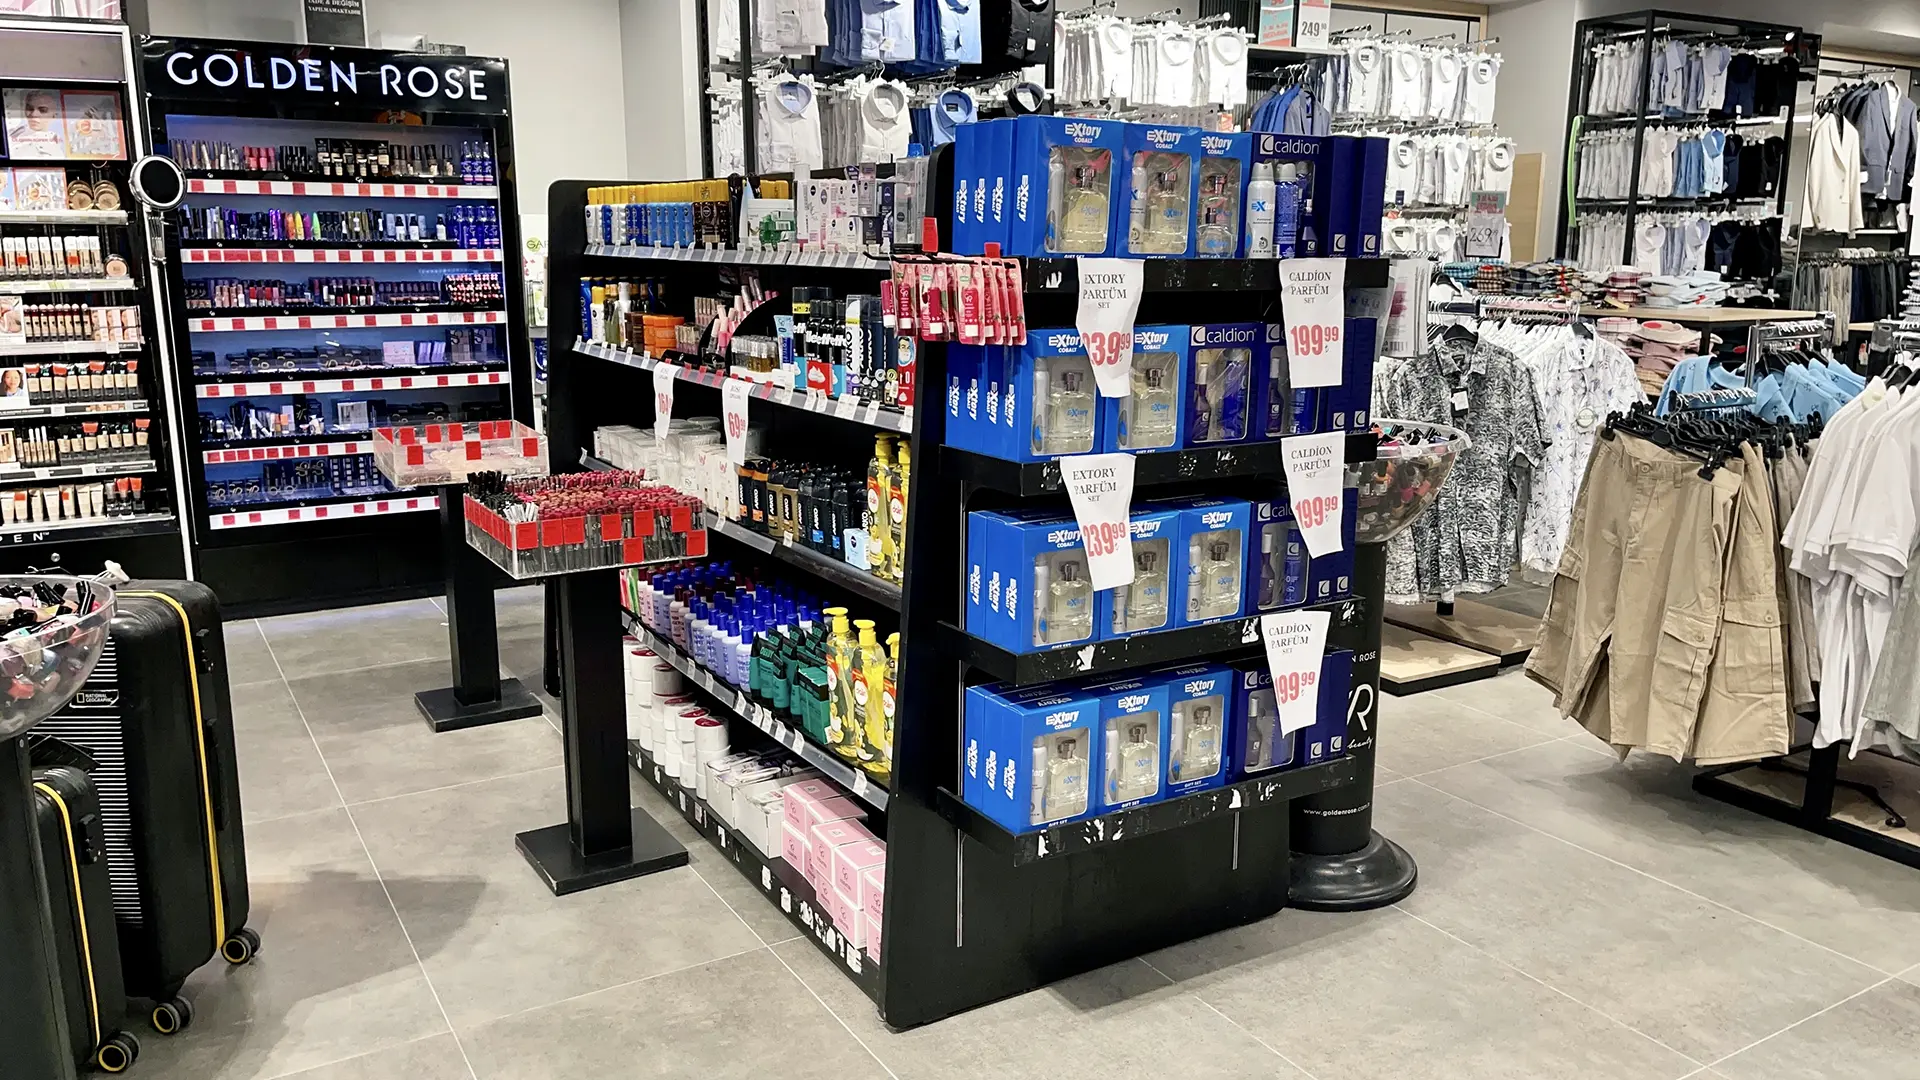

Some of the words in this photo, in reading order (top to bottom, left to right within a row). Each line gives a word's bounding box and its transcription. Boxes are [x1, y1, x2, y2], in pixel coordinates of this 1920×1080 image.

[1301, 21, 1320, 37] 249
[167, 52, 358, 94] GOLDEN
[380, 64, 488, 101] ROSE
[1065, 123, 1102, 139] EXtory
[1146, 129, 1182, 145] EXtory
[1201, 136, 1232, 151] EXtory
[1274, 138, 1319, 155] caldion
[1470, 227, 1492, 242] 269
[1289, 269, 1332, 282] CALDİON
[1291, 283, 1329, 296] PARFÜM
[1134, 331, 1169, 345] EXtory
[1206, 327, 1255, 344] caldion
[1291, 446, 1333, 460] CALDİON
[1293, 459, 1331, 473] PARFÜM
[1073, 468, 1117, 481] EXTORY
[1202, 512, 1233, 525] EXtory
[1269, 623, 1313, 637] CALDİON
[1184, 679, 1215, 694] EXtory
[1118, 694, 1150, 710] EXtory
[1046, 710, 1080, 726] EXtory
